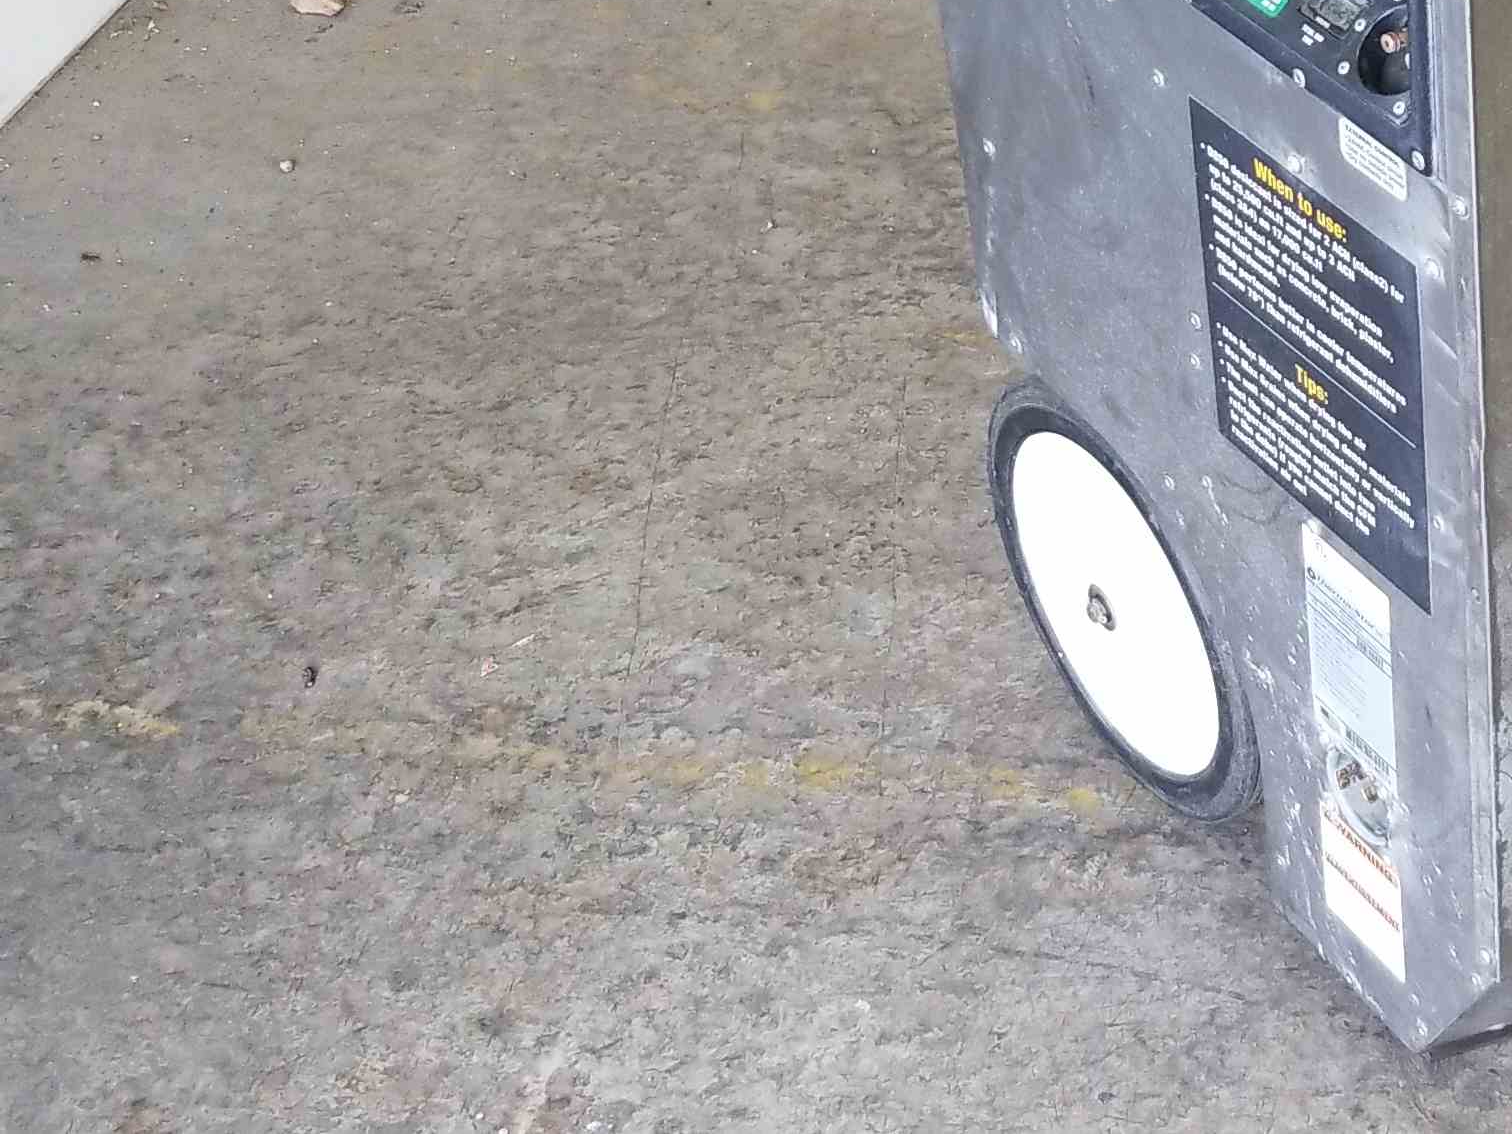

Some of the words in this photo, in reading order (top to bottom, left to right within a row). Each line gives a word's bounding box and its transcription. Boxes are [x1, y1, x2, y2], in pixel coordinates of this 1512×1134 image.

[1214, 227, 1230, 250] and
[1253, 156, 1293, 205] When
[1297, 189, 1312, 219] to
[1315, 203, 1347, 246] use:
[1285, 219, 1301, 243] and
[1212, 211, 1252, 253] materials
[1253, 243, 1274, 270] such
[1330, 304, 1357, 336] brick,
[1358, 327, 1393, 365] plaster,
[1267, 239, 1280, 260] for
[1281, 251, 1309, 283] drying
[1311, 274, 1327, 297] low
[1328, 288, 1383, 341] evaporation
[1238, 264, 1276, 305] performs
[1278, 296, 1304, 327] better
[1346, 351, 1406, 410] temperatures
[1286, 317, 1333, 365] refrigerant
[1294, 362, 1329, 410] Tips:
[1307, 395, 1336, 429] drying
[1337, 419, 1352, 443] the
[1287, 395, 1310, 424] when
[1312, 415, 1339, 449] drying
[1368, 463, 1411, 509] materials
[1309, 430, 1359, 483] horizontally
[1372, 484, 1415, 530] vertically
